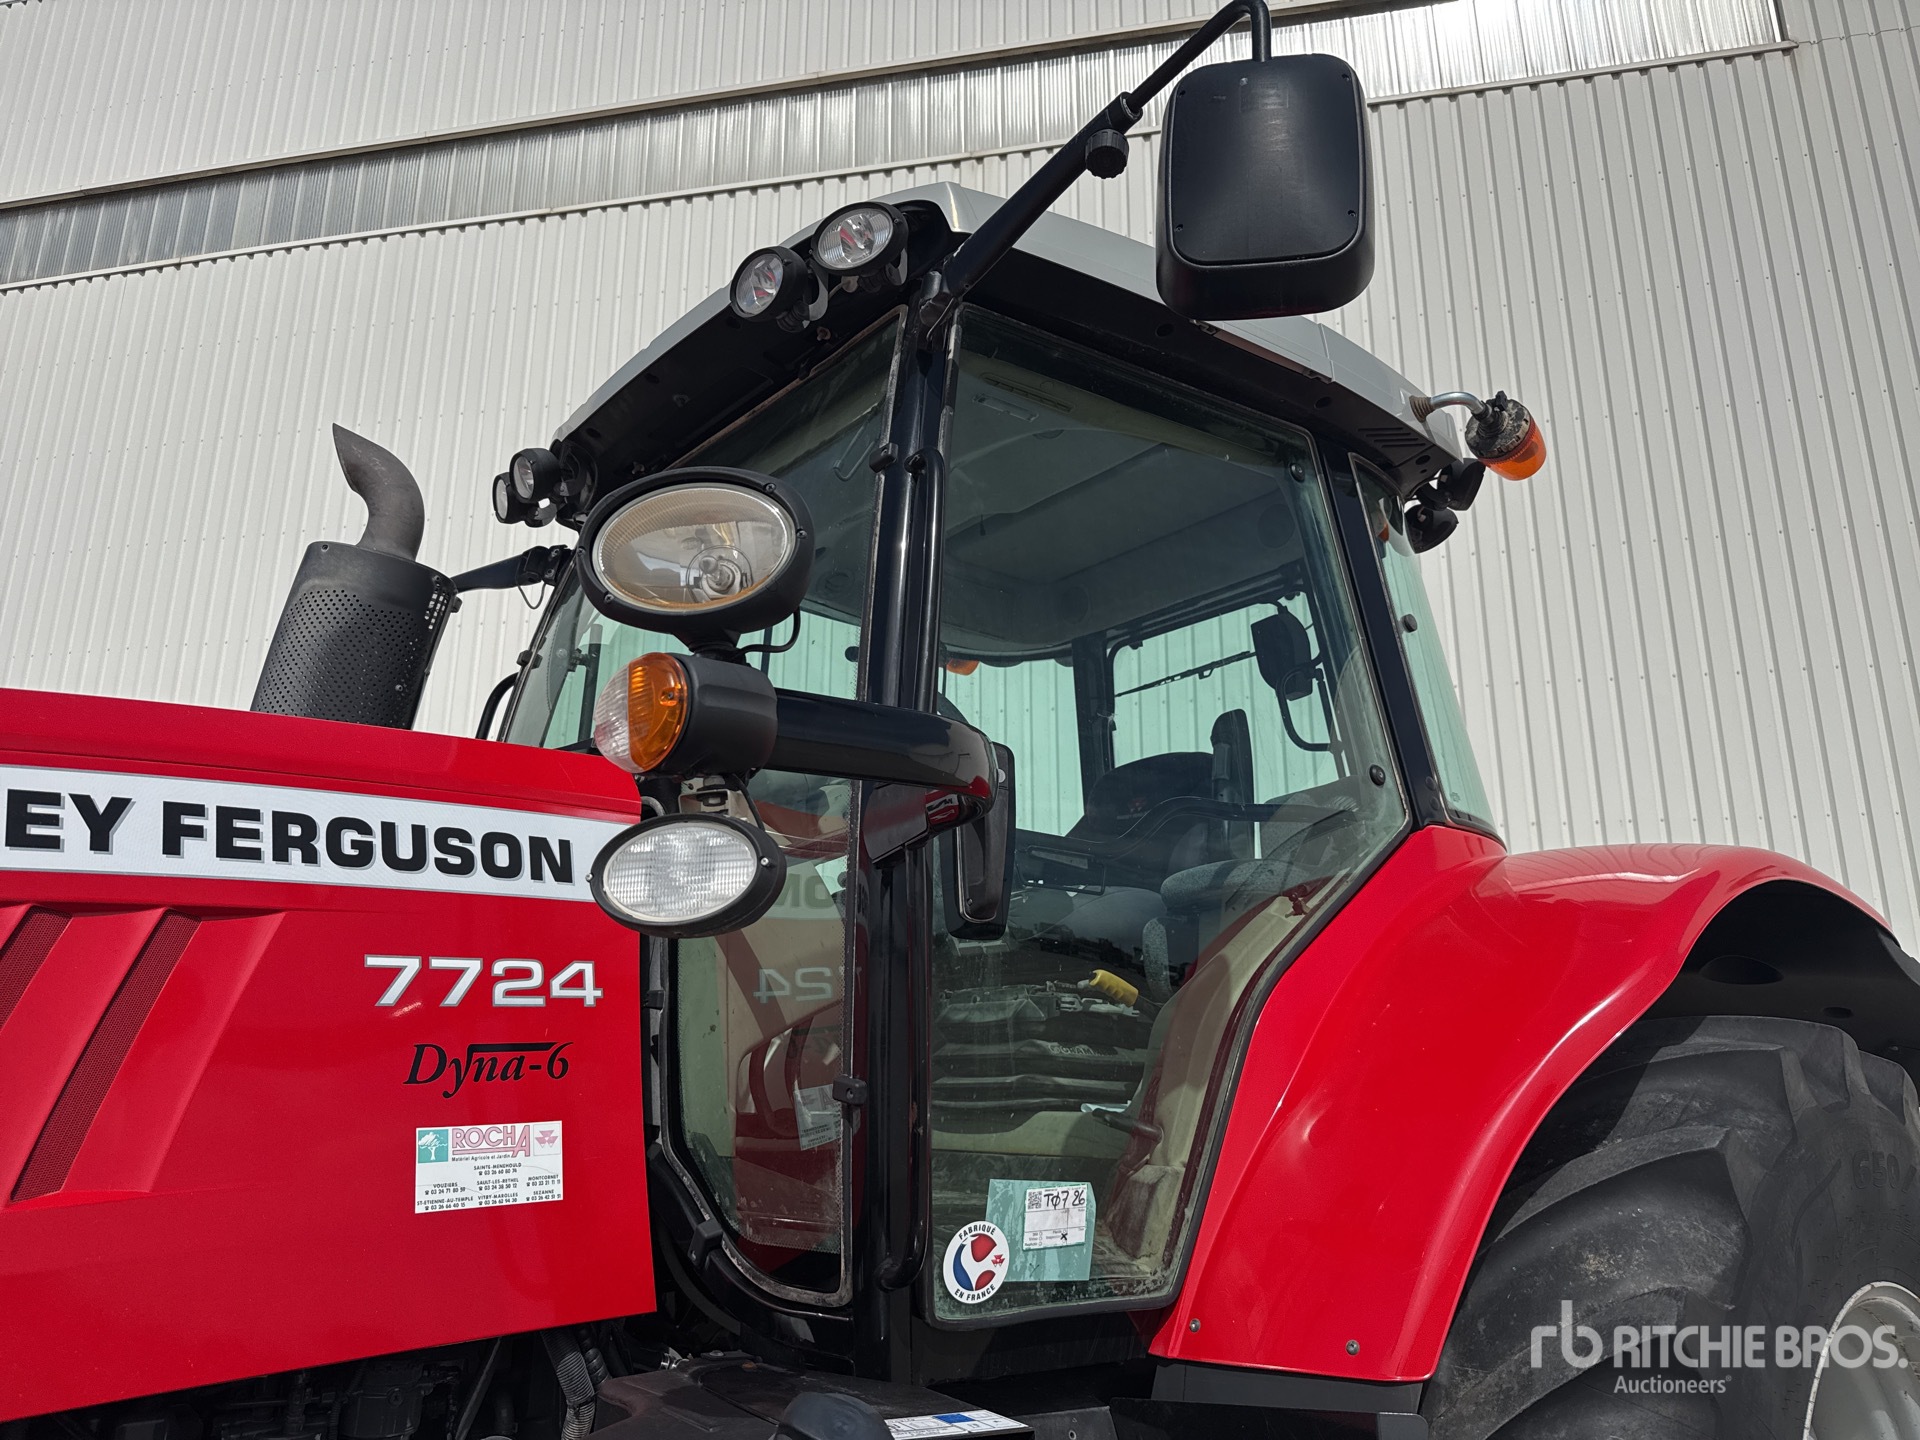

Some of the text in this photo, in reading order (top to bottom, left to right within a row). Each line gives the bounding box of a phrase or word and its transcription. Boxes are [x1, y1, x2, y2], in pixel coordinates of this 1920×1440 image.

[162, 801, 575, 886] FERGUSON
[364, 954, 603, 1007] 7724
[403, 1042, 574, 1099] Dyna-6
[452, 1125, 530, 1158] ROCHA
[954, 1283, 996, 1301] EN FRANCE
